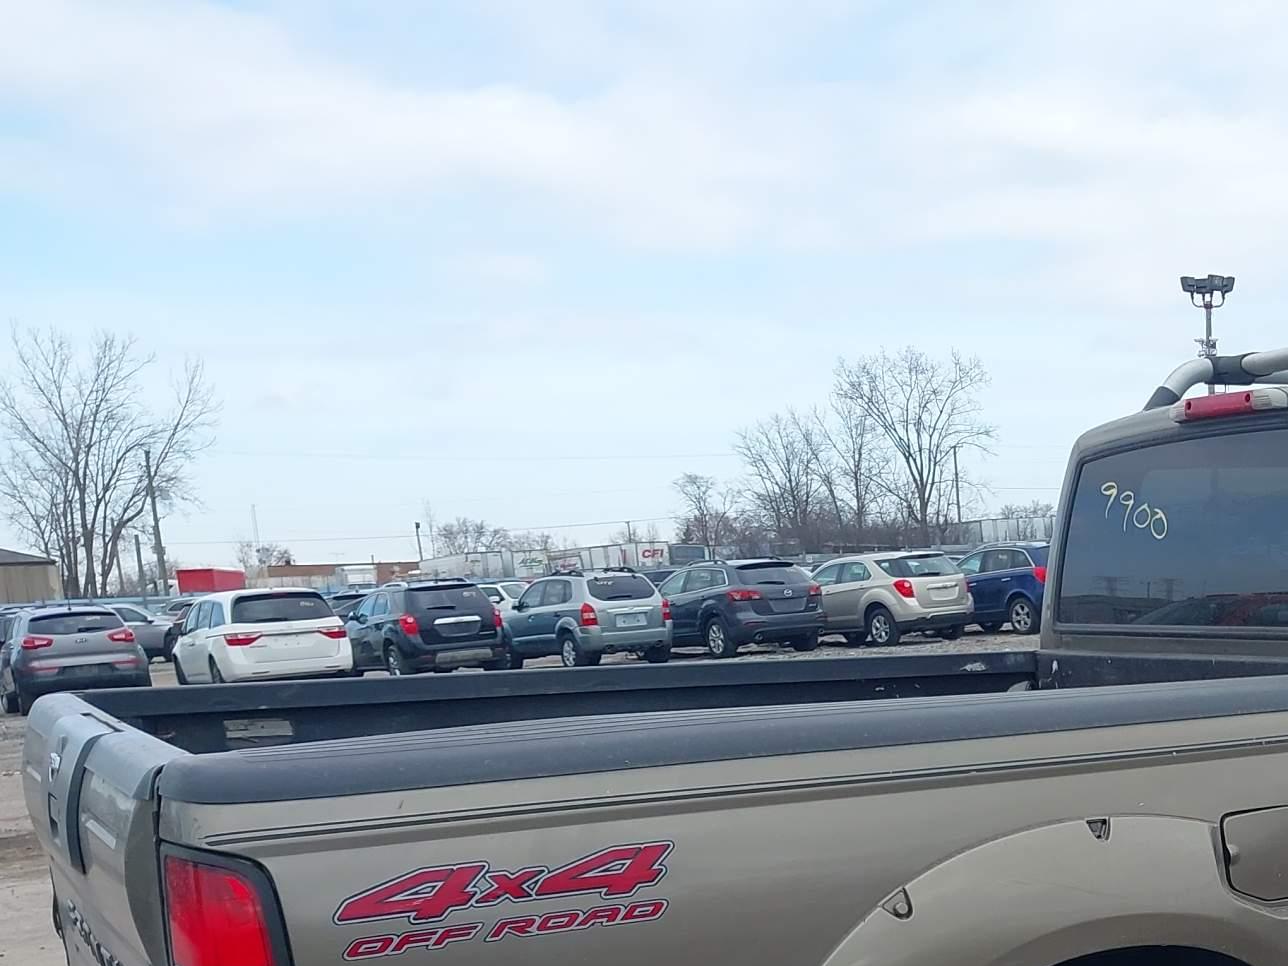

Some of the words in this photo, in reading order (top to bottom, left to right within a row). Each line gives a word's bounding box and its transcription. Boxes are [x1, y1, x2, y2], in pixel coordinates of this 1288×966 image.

[1101, 481, 1168, 540] 9900
[642, 549, 664, 558] CFI
[333, 839, 675, 925] 4x4
[342, 922, 484, 961] OFF
[484, 899, 670, 942] ROAD
